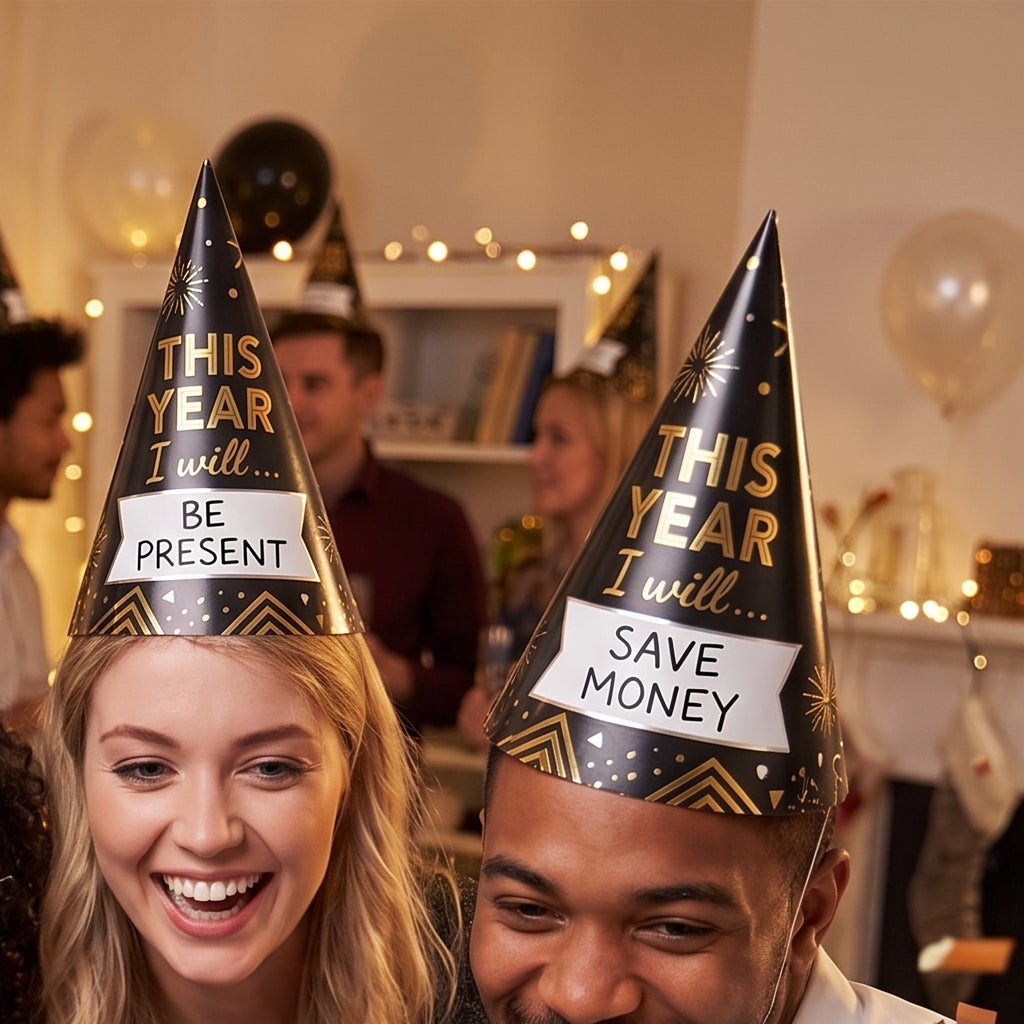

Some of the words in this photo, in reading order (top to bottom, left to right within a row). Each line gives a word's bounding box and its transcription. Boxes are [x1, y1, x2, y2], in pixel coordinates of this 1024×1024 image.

[158, 333, 262, 381] THIS
[147, 385, 275, 435] YEAR
[145, 440, 171, 485] I
[176, 438, 279, 479] will...
[653, 424, 781, 498] THIS
[182, 499, 225, 530] BE
[626, 485, 778, 567] YEAR
[137, 537, 287, 571] PRESENT
[602, 548, 645, 597] I
[641, 566, 768, 621] will...
[609, 625, 725, 677] SAVE
[581, 667, 739, 732] MONEY
